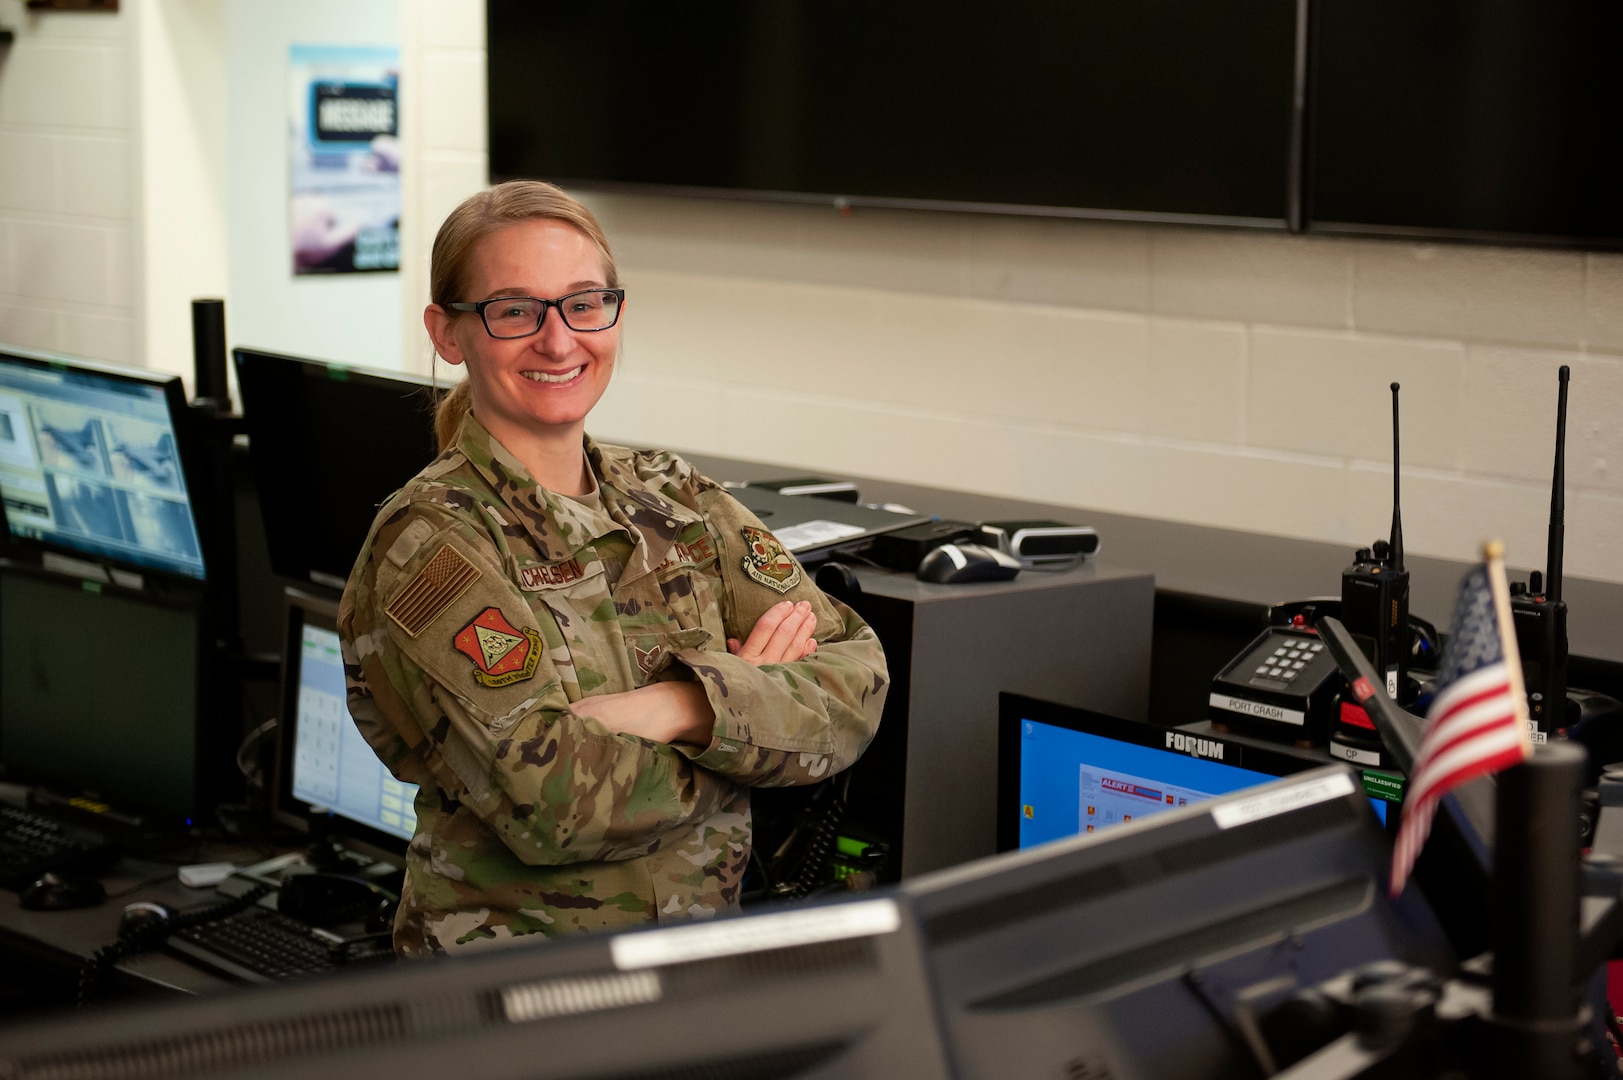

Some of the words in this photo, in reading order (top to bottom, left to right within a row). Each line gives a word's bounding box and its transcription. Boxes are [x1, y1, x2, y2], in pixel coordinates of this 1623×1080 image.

[751, 570, 764, 581] AIR
[1389, 679, 1395, 694] CP
[1229, 699, 1252, 712] PORT
[1253, 704, 1283, 719] CRASH
[1165, 731, 1224, 760] FORUM
[1346, 749, 1358, 759] CP
[1102, 779, 1127, 792] ALERT
[1363, 775, 1402, 790] UNCLASSIFIED
